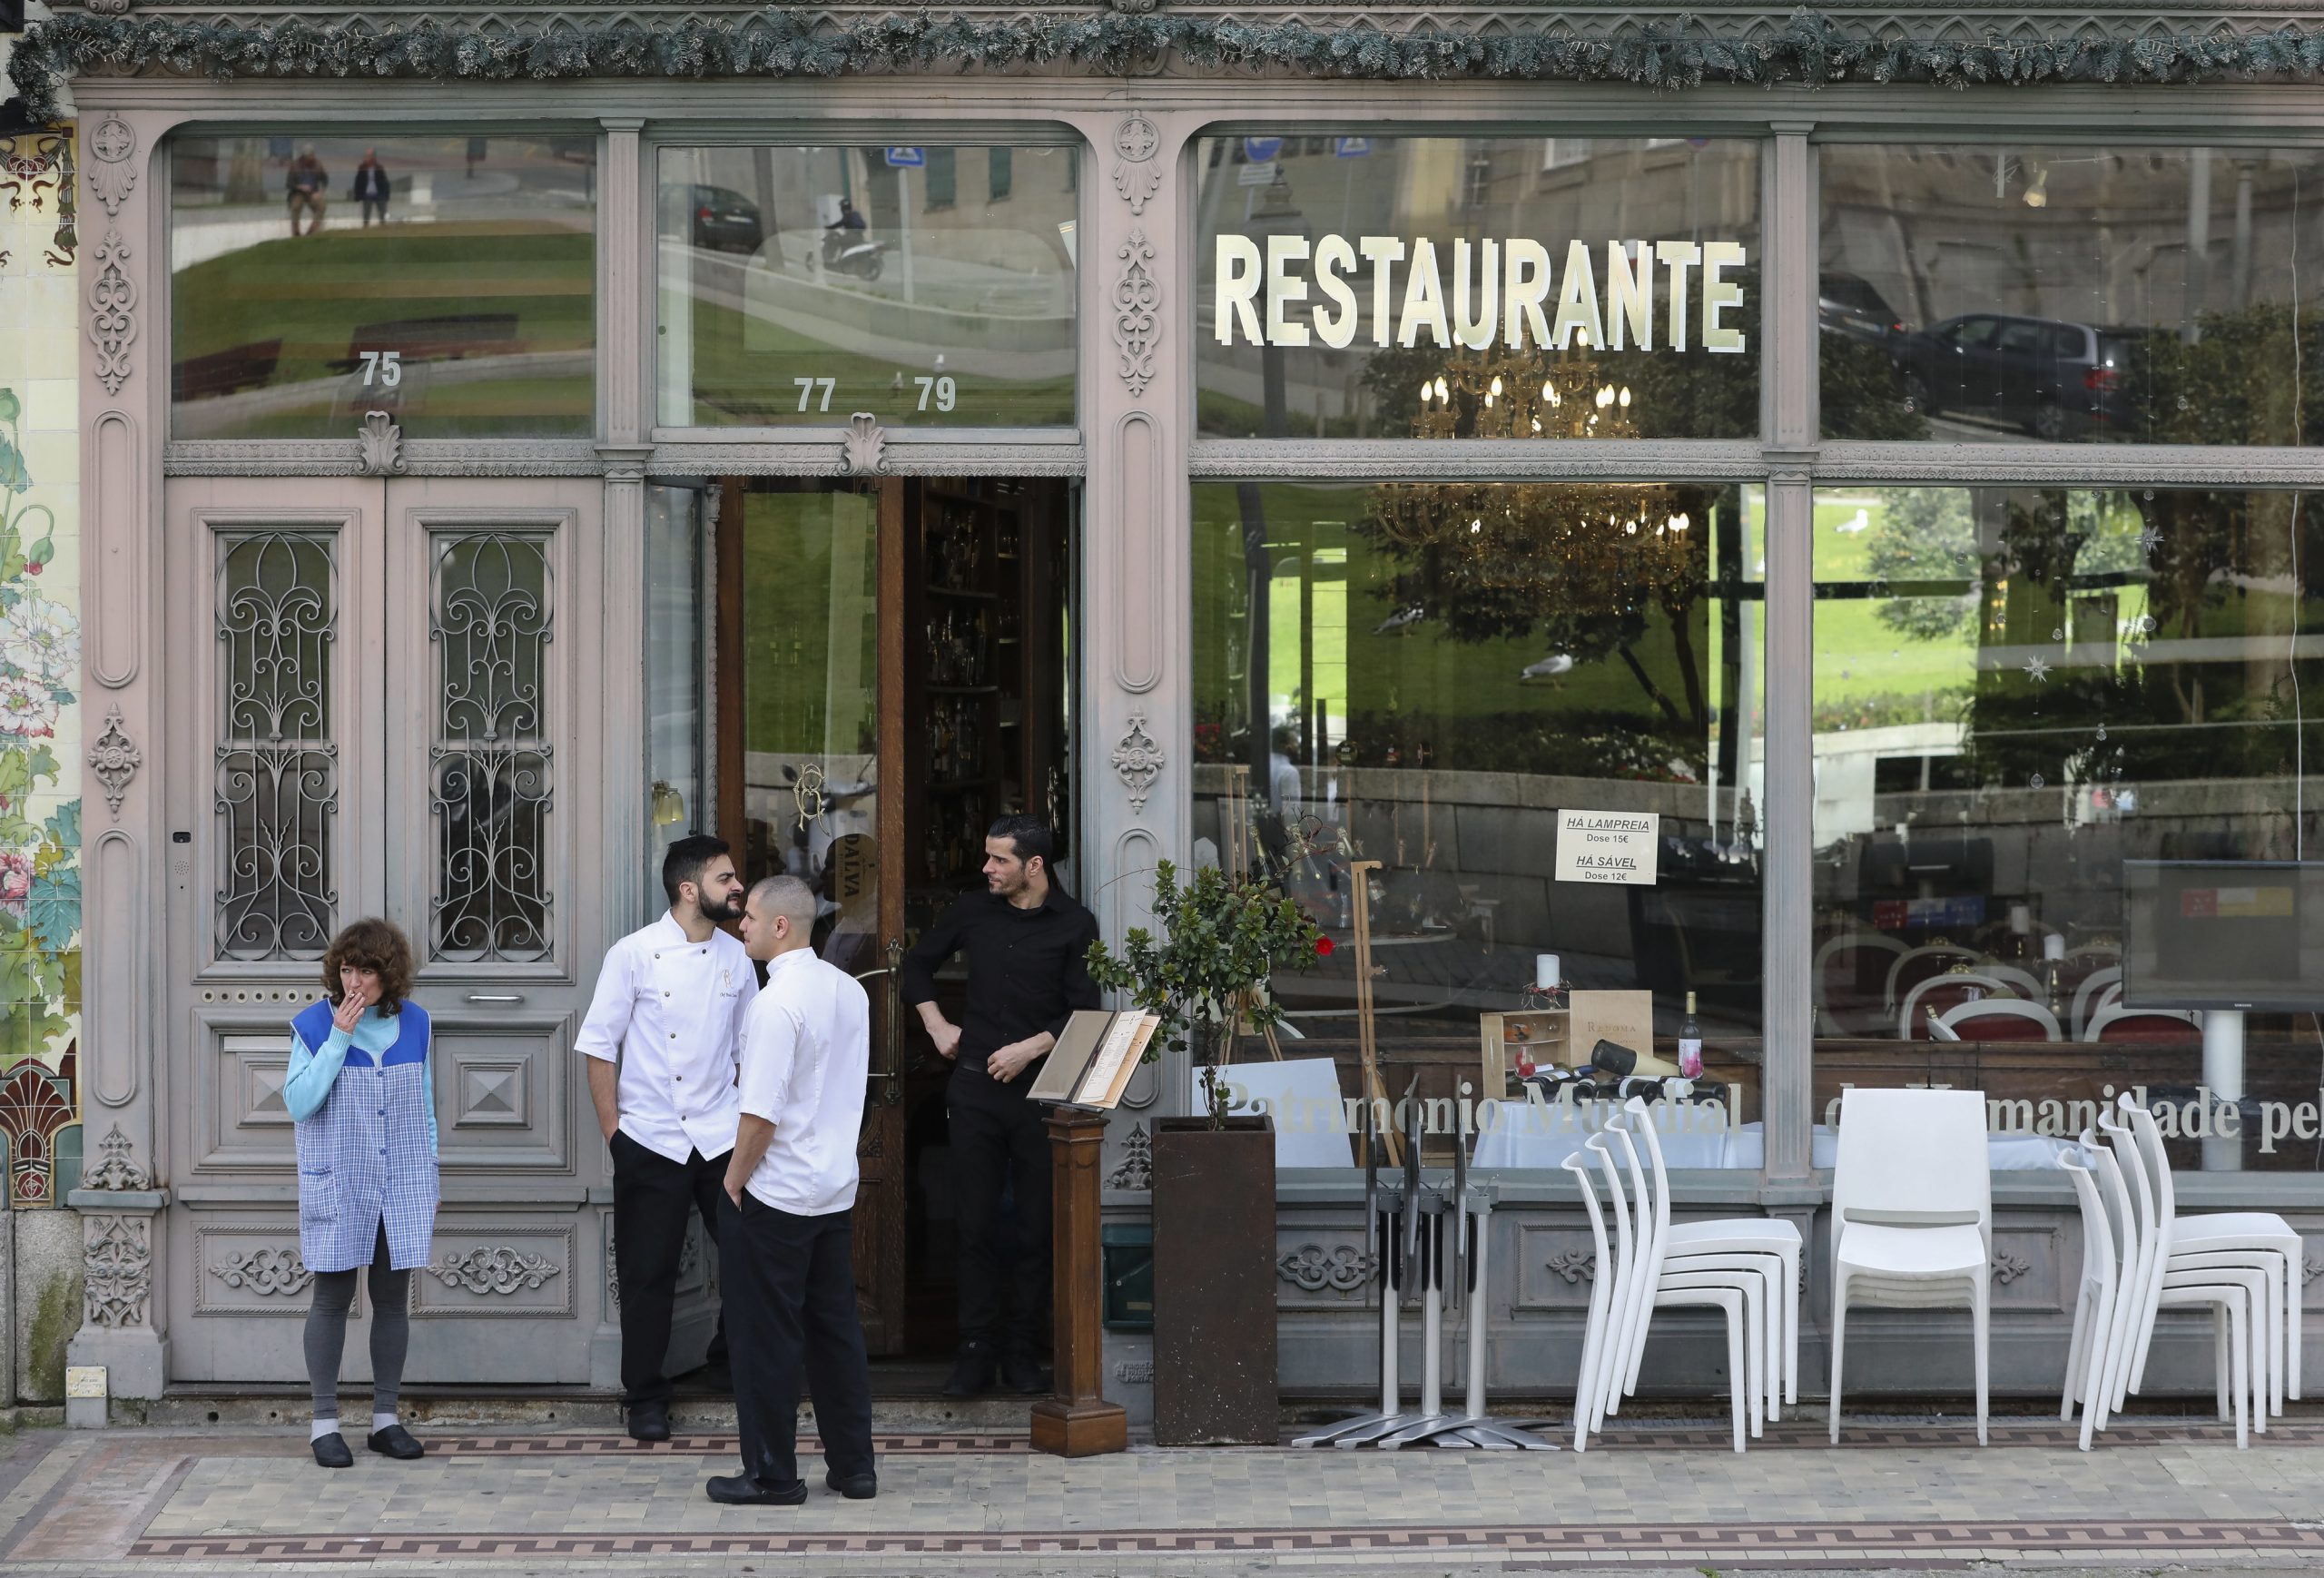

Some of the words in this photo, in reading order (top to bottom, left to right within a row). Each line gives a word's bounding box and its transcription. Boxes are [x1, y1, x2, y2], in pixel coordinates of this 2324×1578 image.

[1215, 234, 1746, 353] RESTAURANTE
[359, 350, 400, 386] 75
[794, 377, 836, 412] 77
[914, 376, 956, 412] 79
[1567, 816, 1584, 828] HÁ
[1588, 818, 1649, 831] LAMPREIA
[1587, 833, 1610, 843] Dose
[1613, 834, 1629, 843] 15€
[844, 833, 860, 898] DALVA
[1576, 854, 1593, 865] HÁ
[1597, 854, 1637, 868] SÁVEL
[1585, 872, 1609, 881] Dose
[1611, 873, 1627, 881] 12€
[1906, 1083, 2240, 1139] manidade
